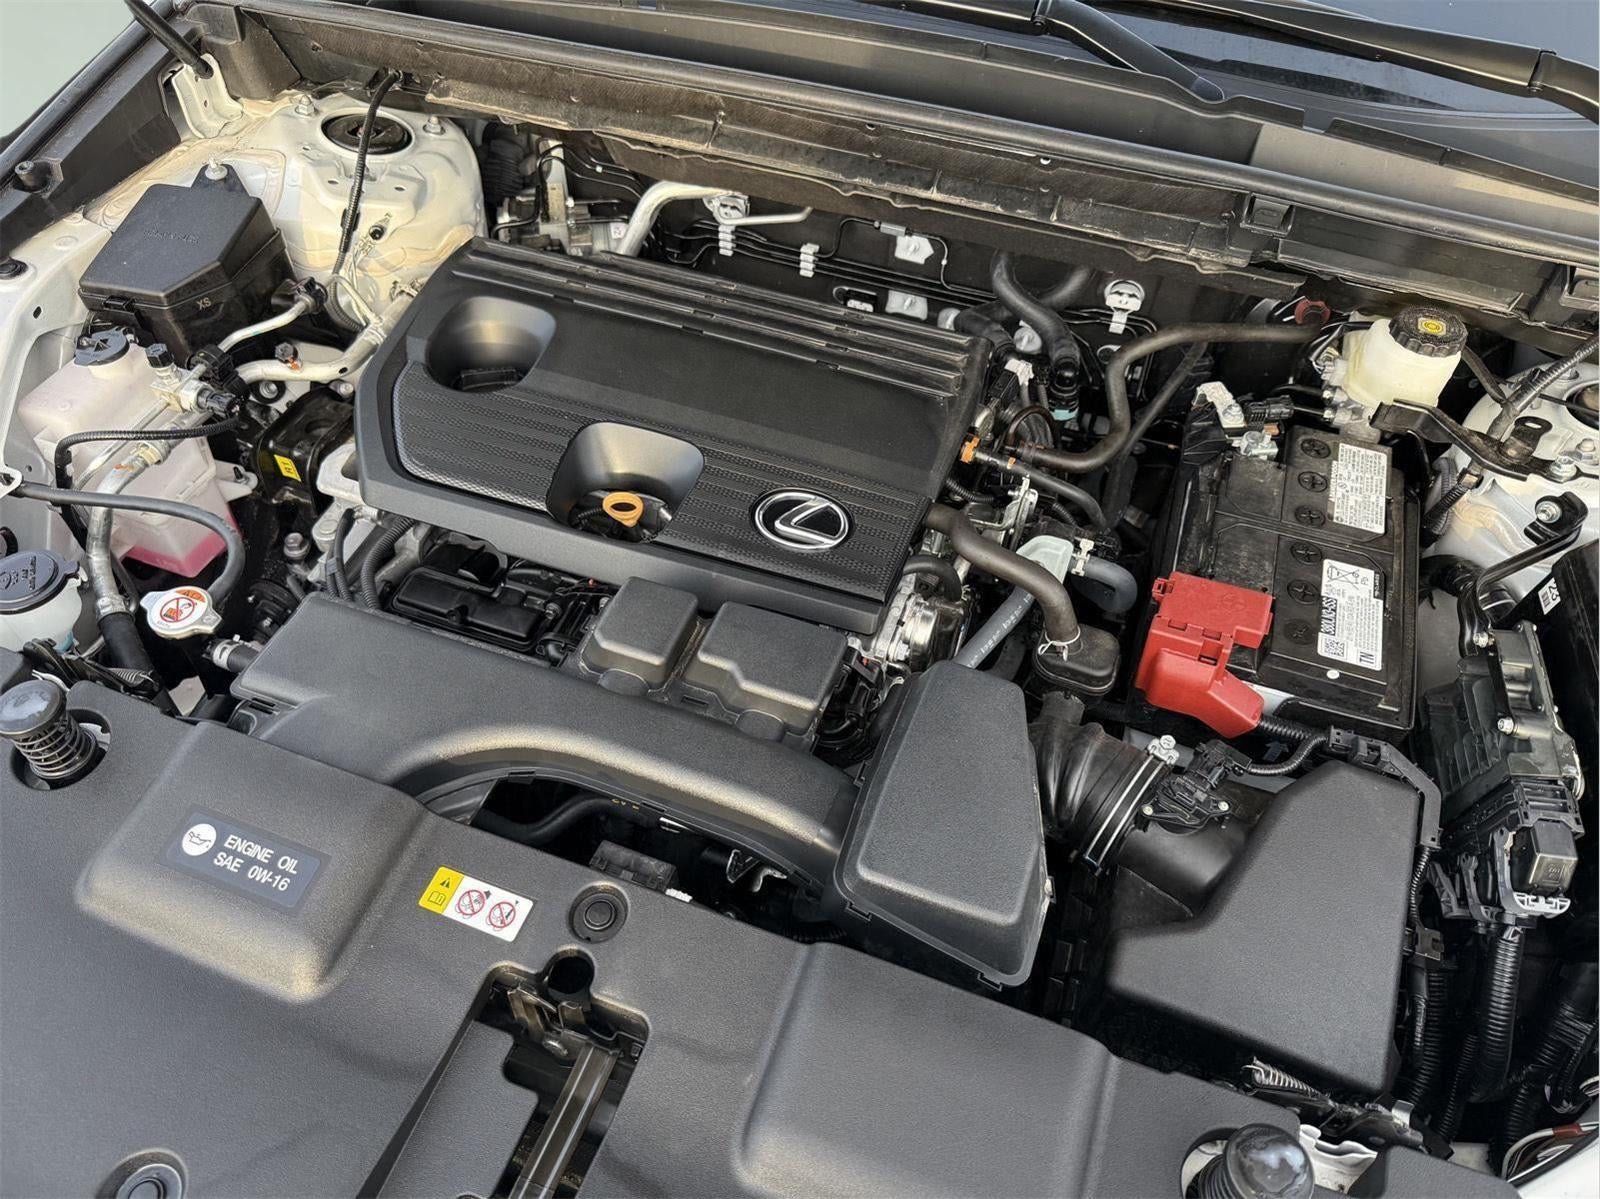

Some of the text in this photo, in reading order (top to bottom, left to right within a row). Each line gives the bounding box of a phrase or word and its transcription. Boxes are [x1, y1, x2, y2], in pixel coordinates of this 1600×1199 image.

[1360, 652, 1374, 664] TN
[213, 852, 290, 891] SAE 0W-16
[224, 834, 298, 875] ENGINE OIL
